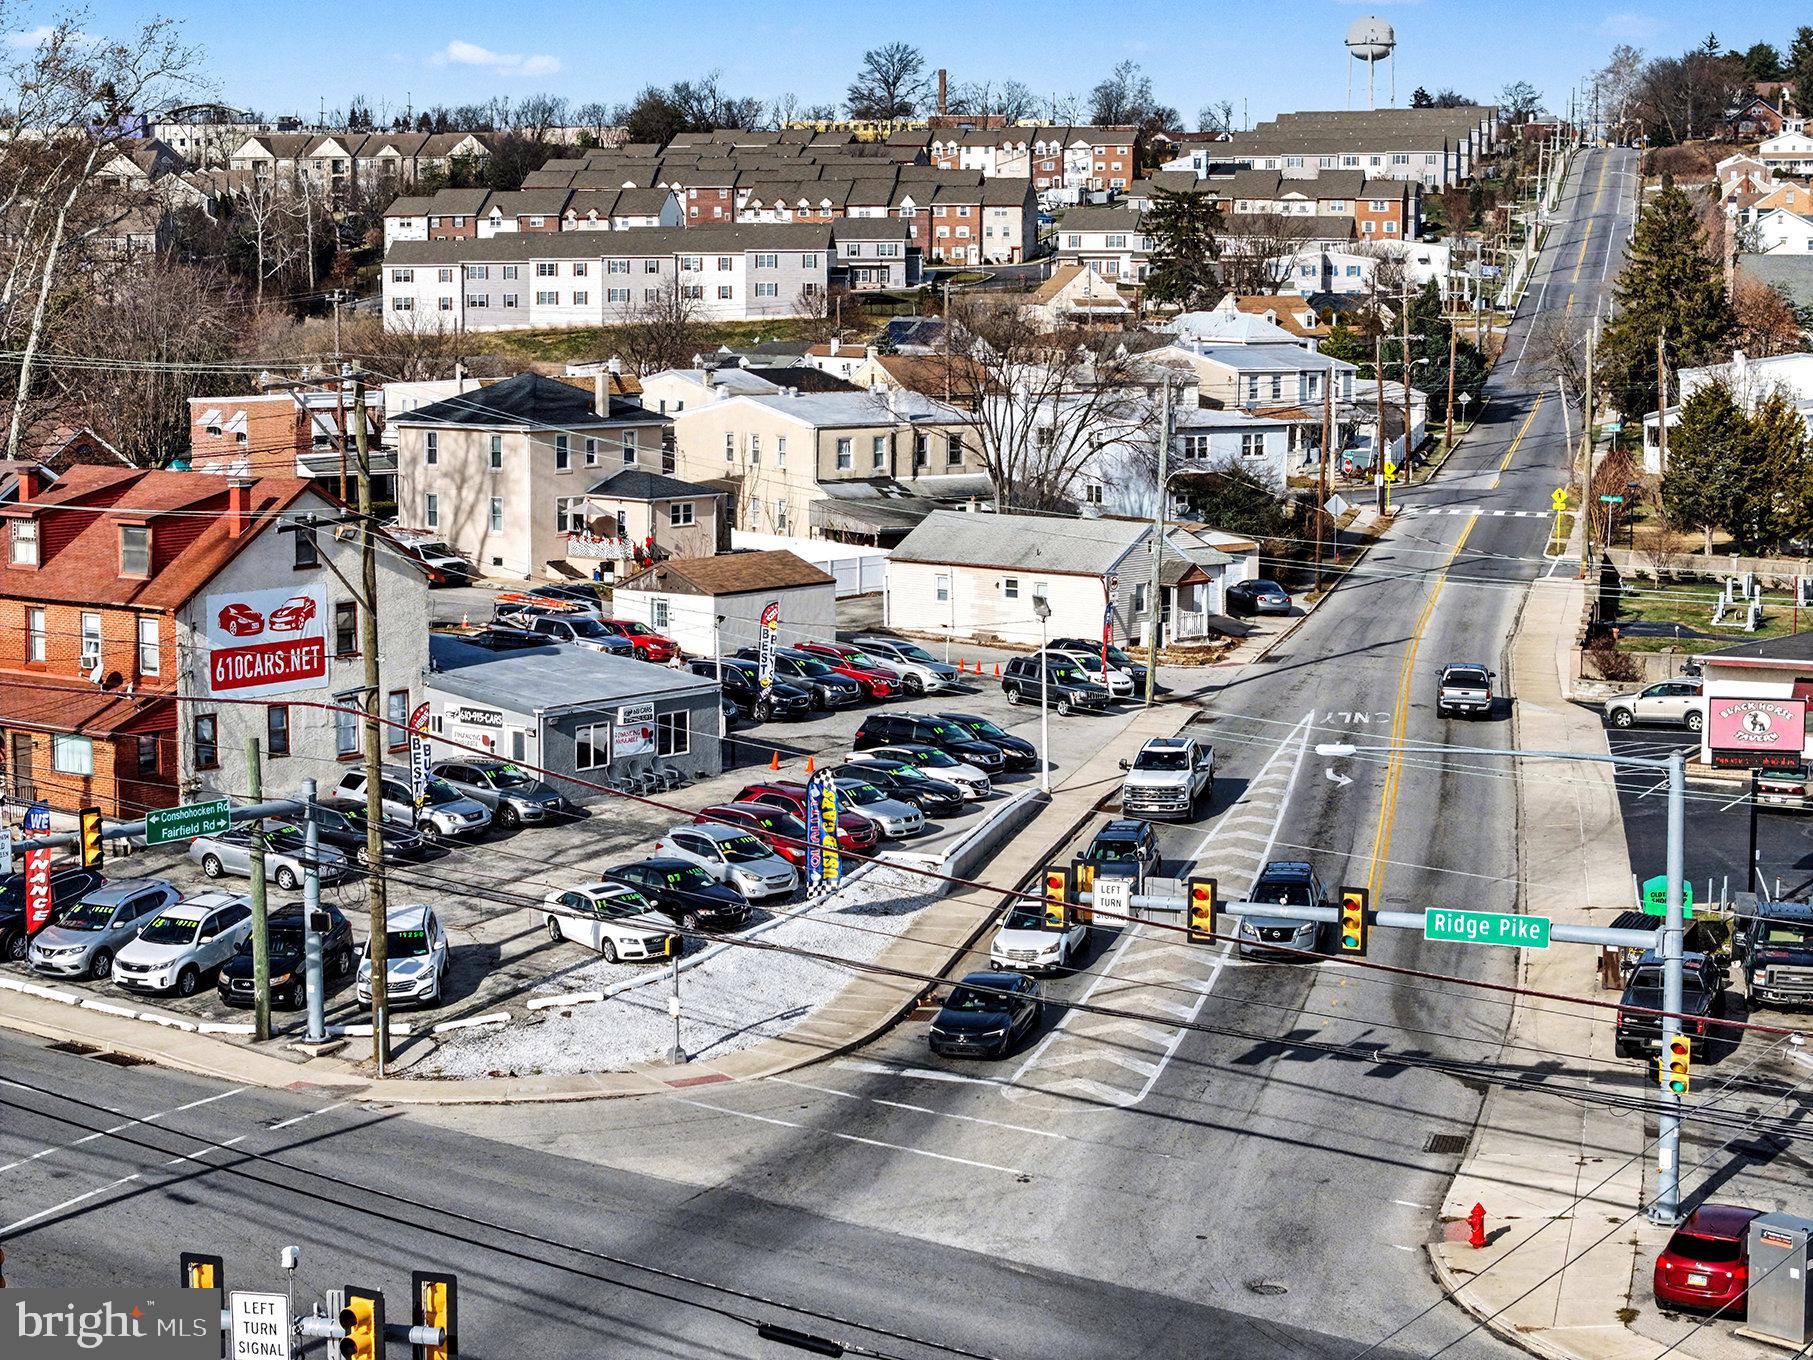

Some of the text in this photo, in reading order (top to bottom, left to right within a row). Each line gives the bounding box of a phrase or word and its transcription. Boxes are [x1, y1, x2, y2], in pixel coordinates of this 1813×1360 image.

[761, 629, 769, 675] BEST
[216, 645, 320, 682] 610CARS.NET
[460, 710, 502, 725] 610-915-CARS
[1719, 702, 1794, 720] BLACK HORSE
[1734, 730, 1779, 743] TAVERN
[412, 738, 421, 793] BEST
[31, 813, 49, 829] WE
[161, 802, 229, 823] Conshohocken Rd
[162, 820, 215, 838] Fairfield Rd
[29, 834, 50, 921] INANCE
[1101, 885, 1121, 894] LEFT
[1100, 898, 1122, 907] TURN
[1434, 913, 1541, 940] Ridge Pike
[244, 1301, 275, 1315] LEFT
[243, 1321, 277, 1335] TURN
[238, 1341, 285, 1357] SIGNAL
